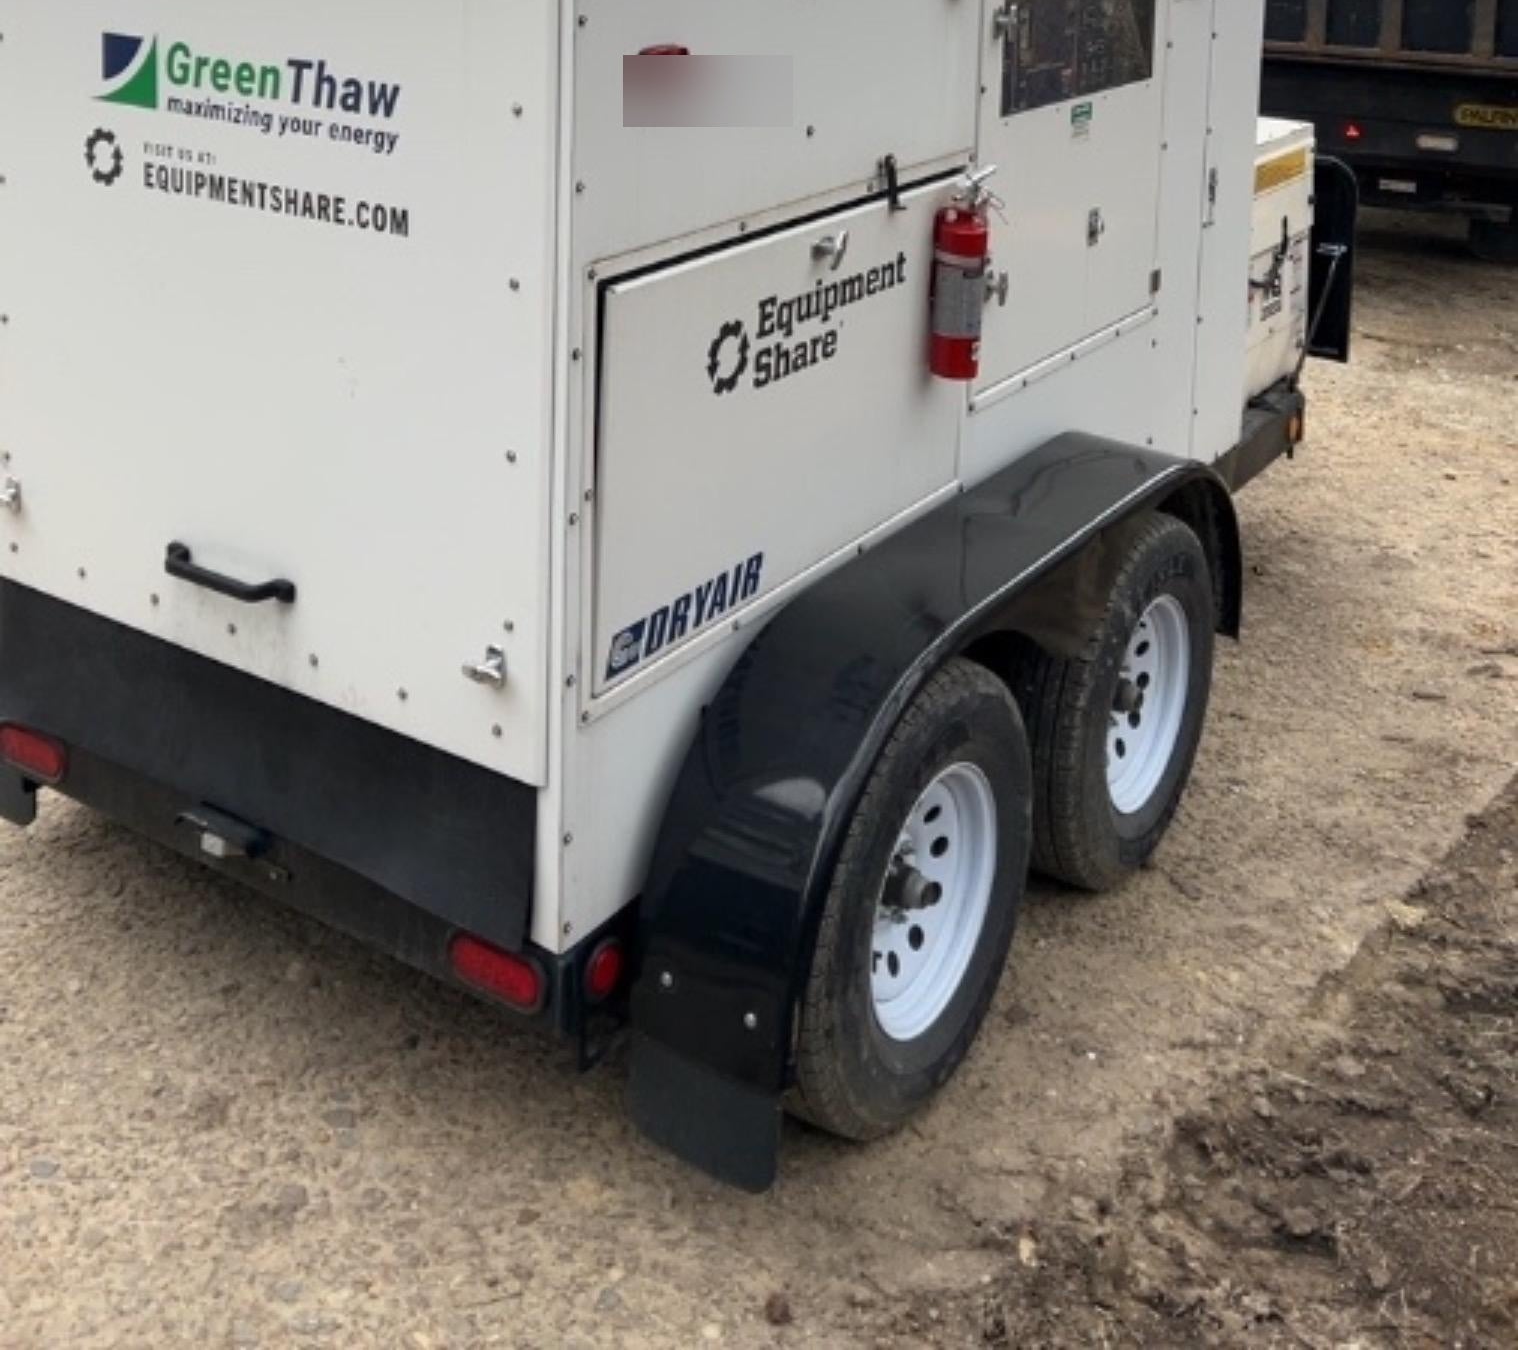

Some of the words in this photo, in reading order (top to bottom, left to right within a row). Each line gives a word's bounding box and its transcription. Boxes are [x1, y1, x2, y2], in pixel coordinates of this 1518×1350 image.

[167, 96, 272, 134] maximizing
[278, 111, 322, 136] your
[329, 122, 400, 155] energy
[143, 161, 410, 238] EQUIPMENTSHARE.COM
[756, 251, 907, 339] Equipment
[753, 329, 838, 389] Share
[644, 551, 765, 659] DRYAIR
